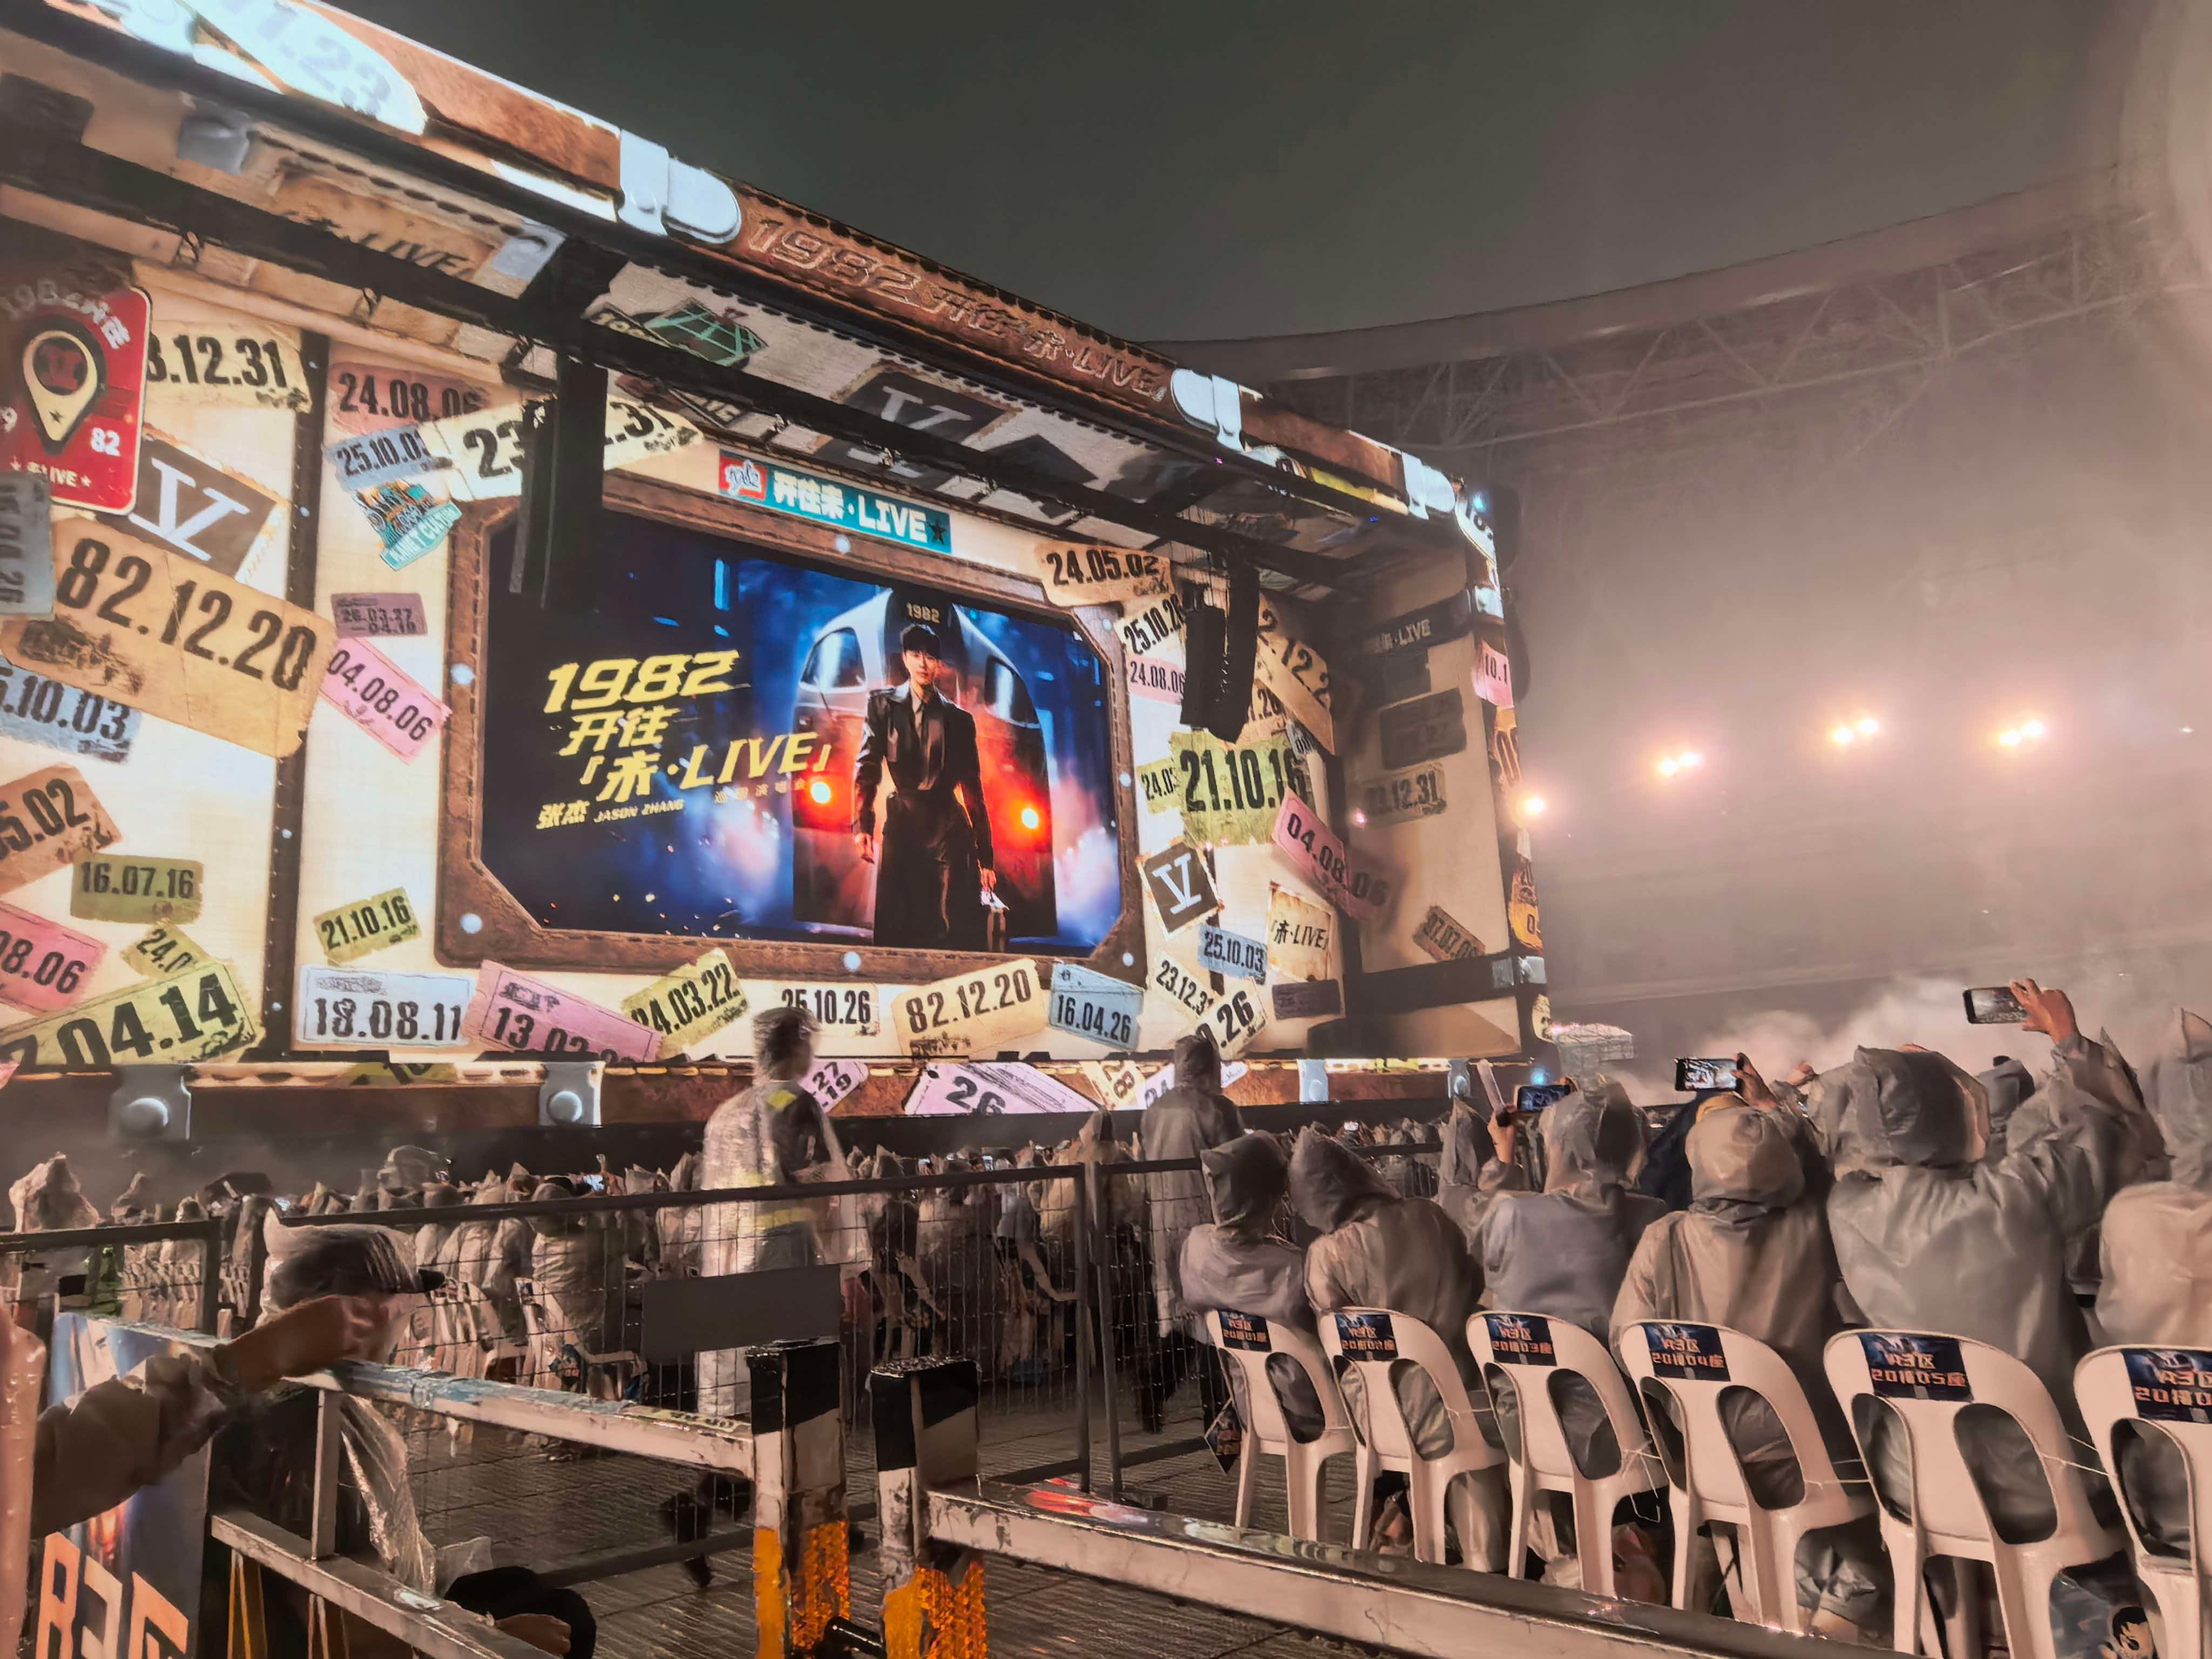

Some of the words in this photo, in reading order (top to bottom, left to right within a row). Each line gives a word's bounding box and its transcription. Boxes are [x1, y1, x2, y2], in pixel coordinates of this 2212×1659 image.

[747, 219, 921, 308] 1982
[91, 427, 121, 457] 82
[129, 457, 251, 562] V
[1046, 549, 1159, 586] 24.05.02
[56, 537, 318, 692] 82.12.20
[907, 602, 940, 623] 1982
[327, 649, 434, 742] 04.08.06
[543, 650, 751, 714] 1982
[559, 705, 679, 756] 开往
[593, 806, 638, 823] JASON
[642, 799, 685, 815] ZHANG
[81, 861, 194, 900] 16.07.16
[1151, 855, 1203, 915] V
[320, 895, 410, 950] 21.10.16
[1204, 931, 1267, 973] 25.10.03
[906, 969, 1032, 1034] 82.12.20
[1057, 994, 1132, 1043] 16.04.26
